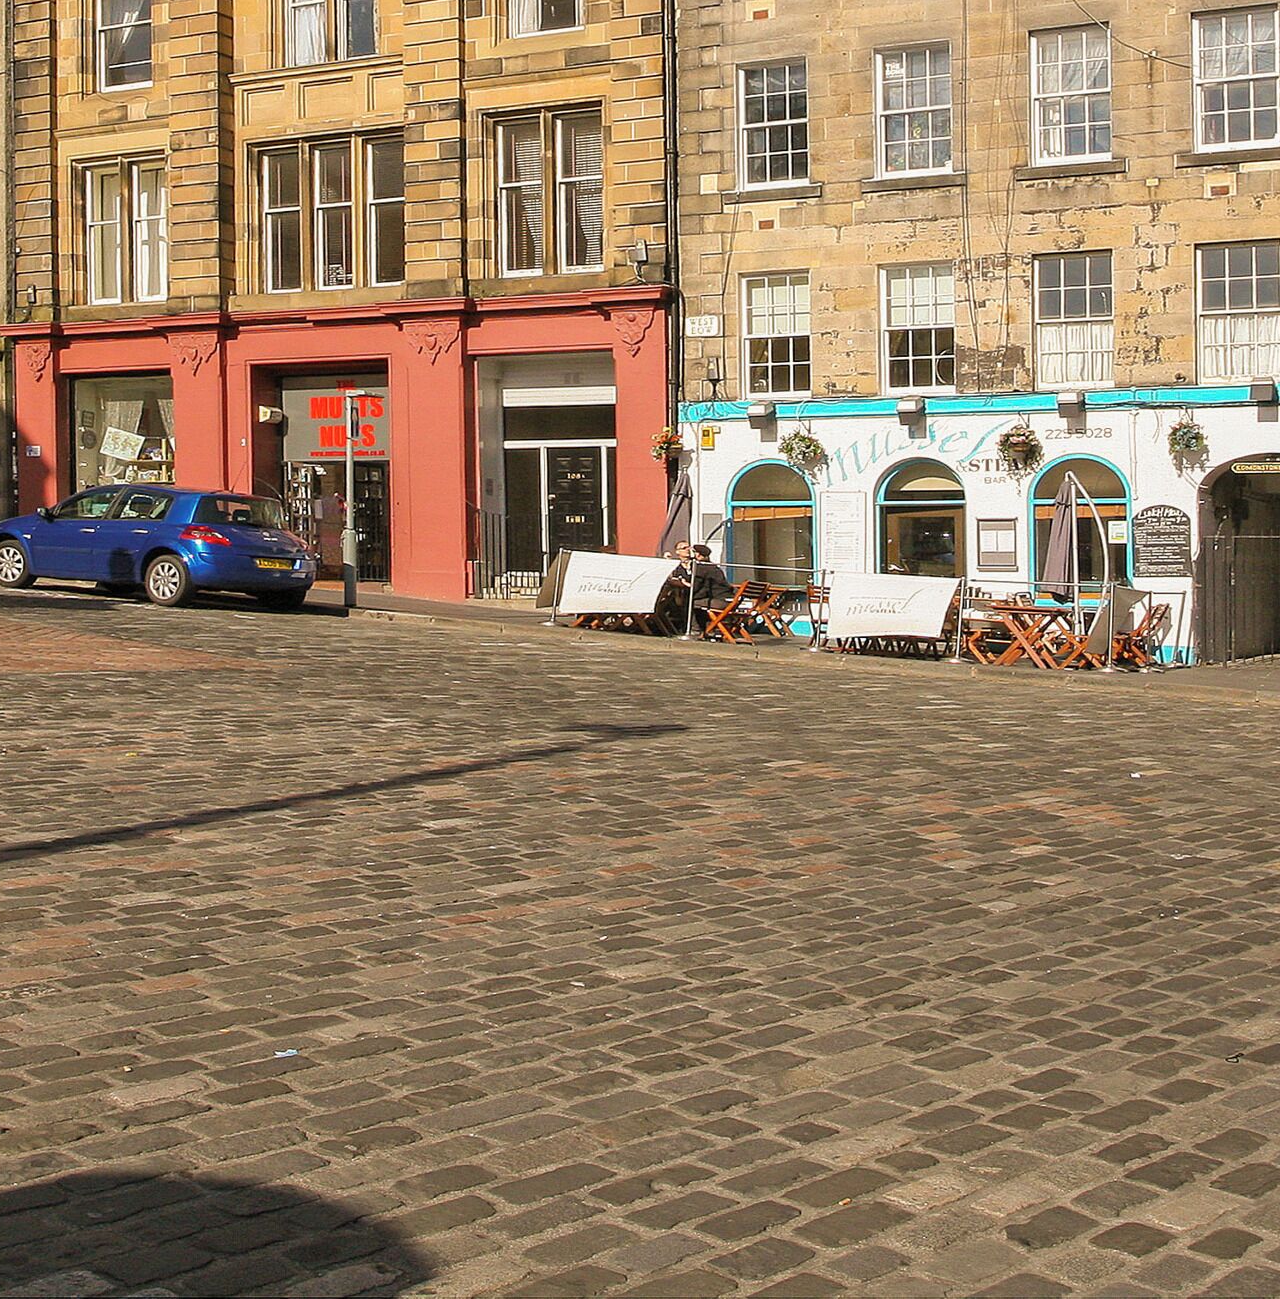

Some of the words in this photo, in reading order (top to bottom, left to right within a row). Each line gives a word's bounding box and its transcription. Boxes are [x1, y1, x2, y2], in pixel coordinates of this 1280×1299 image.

[689, 317, 715, 326] WEST
[691, 326, 712, 335] BOW
[309, 396, 385, 419] MUTS
[319, 423, 377, 448] NUS
[1076, 427, 1113, 439] 5028
[984, 476, 1007, 485] BAR
